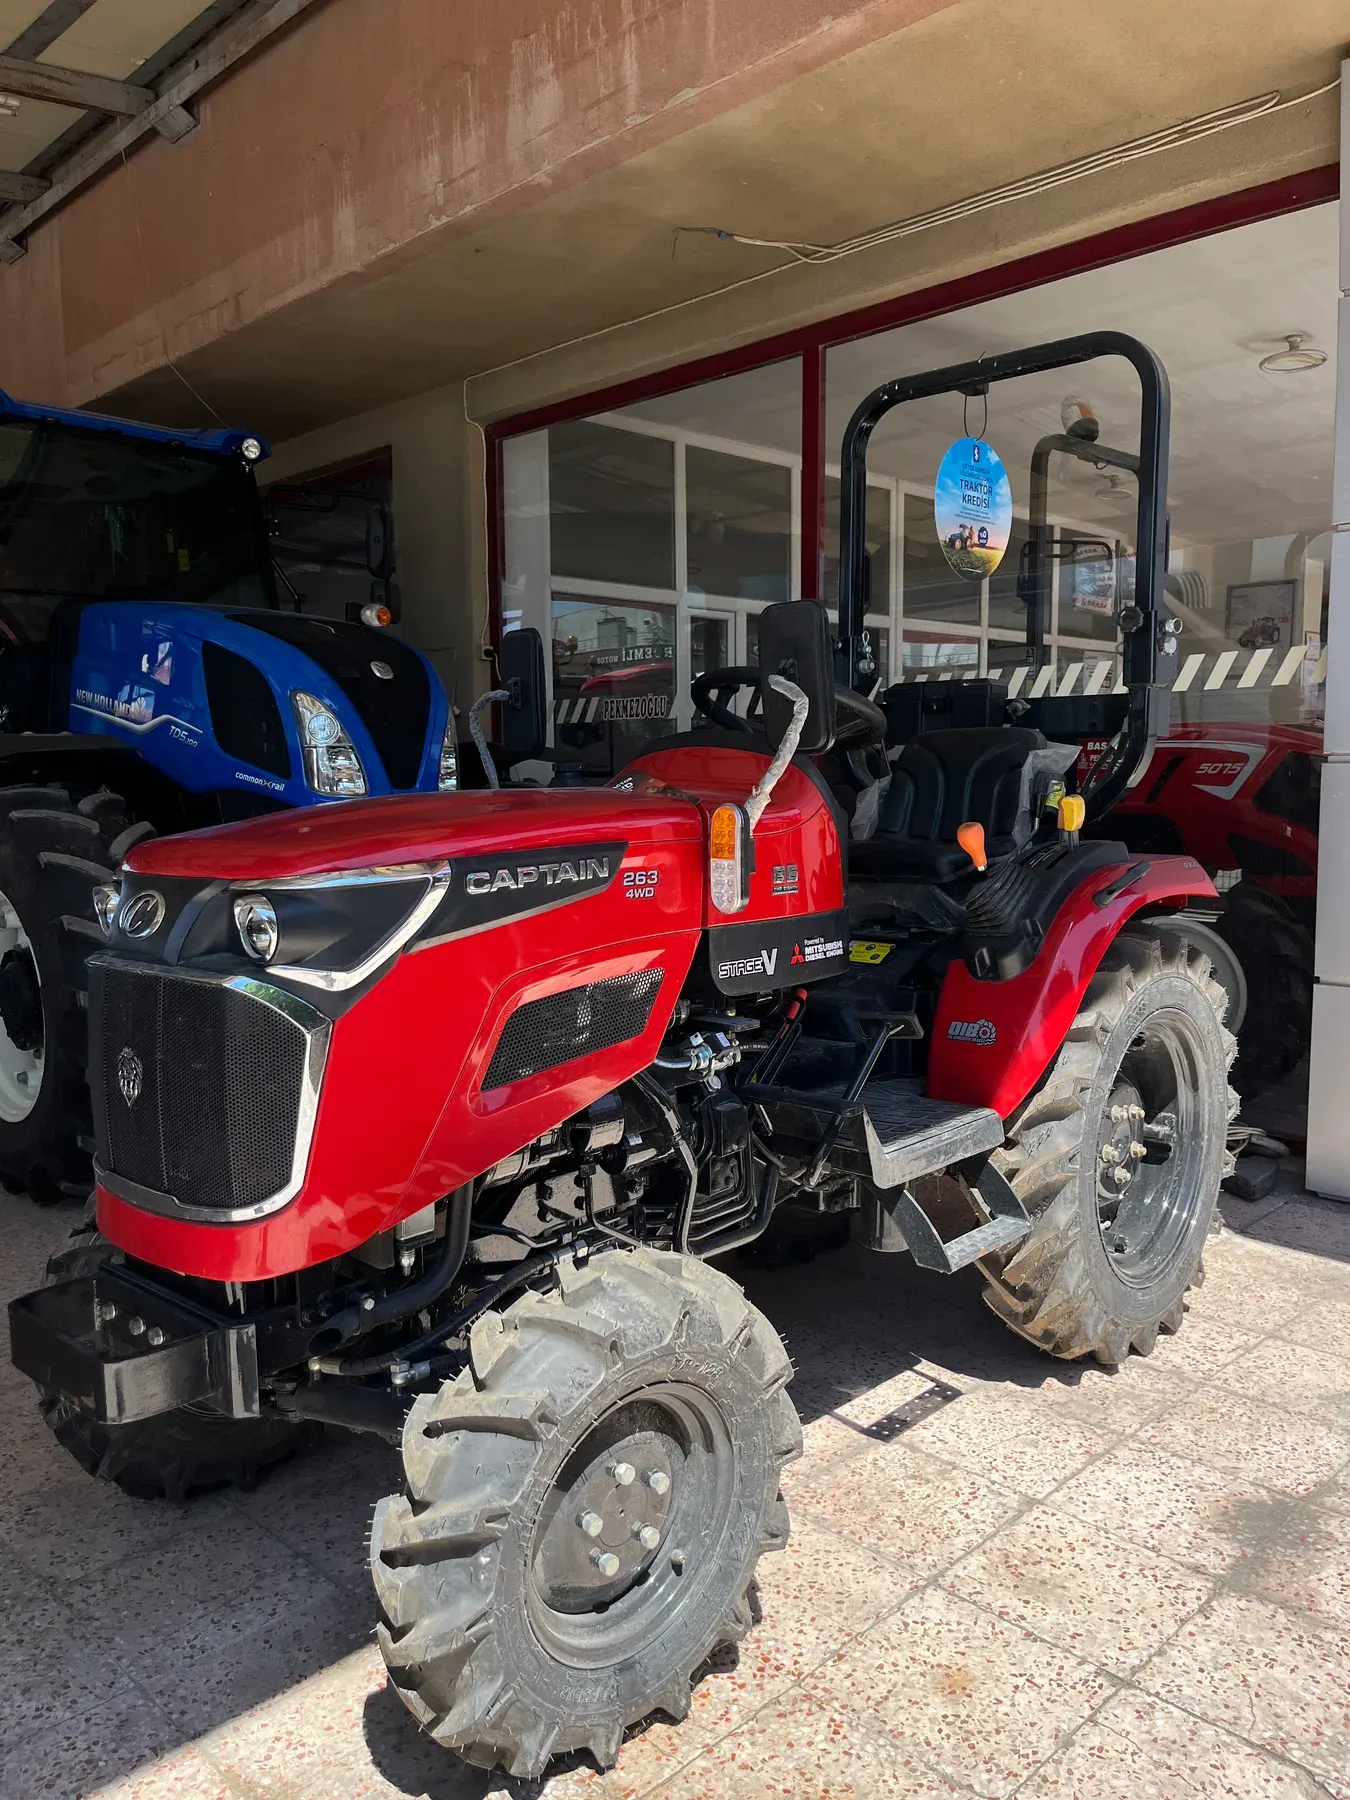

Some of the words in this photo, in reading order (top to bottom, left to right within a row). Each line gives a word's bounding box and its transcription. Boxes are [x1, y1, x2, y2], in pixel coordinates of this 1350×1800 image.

[959, 478, 993, 497] TRAKTÖR
[961, 492, 990, 509] KREDİSİ
[76, 689, 93, 704] NEW
[94, 694, 131, 717] HOLLAND
[603, 693, 667, 720] PEKMEZOĞLU
[1195, 763, 1244, 774] 5075
[466, 857, 609, 895] CAPTAIN
[623, 870, 659, 887] 263
[625, 887, 655, 899] 4WD
[804, 940, 843, 955] MITSUBISHI
[805, 952, 826, 962] DIESEL
[826, 948, 844, 958] ENGINE
